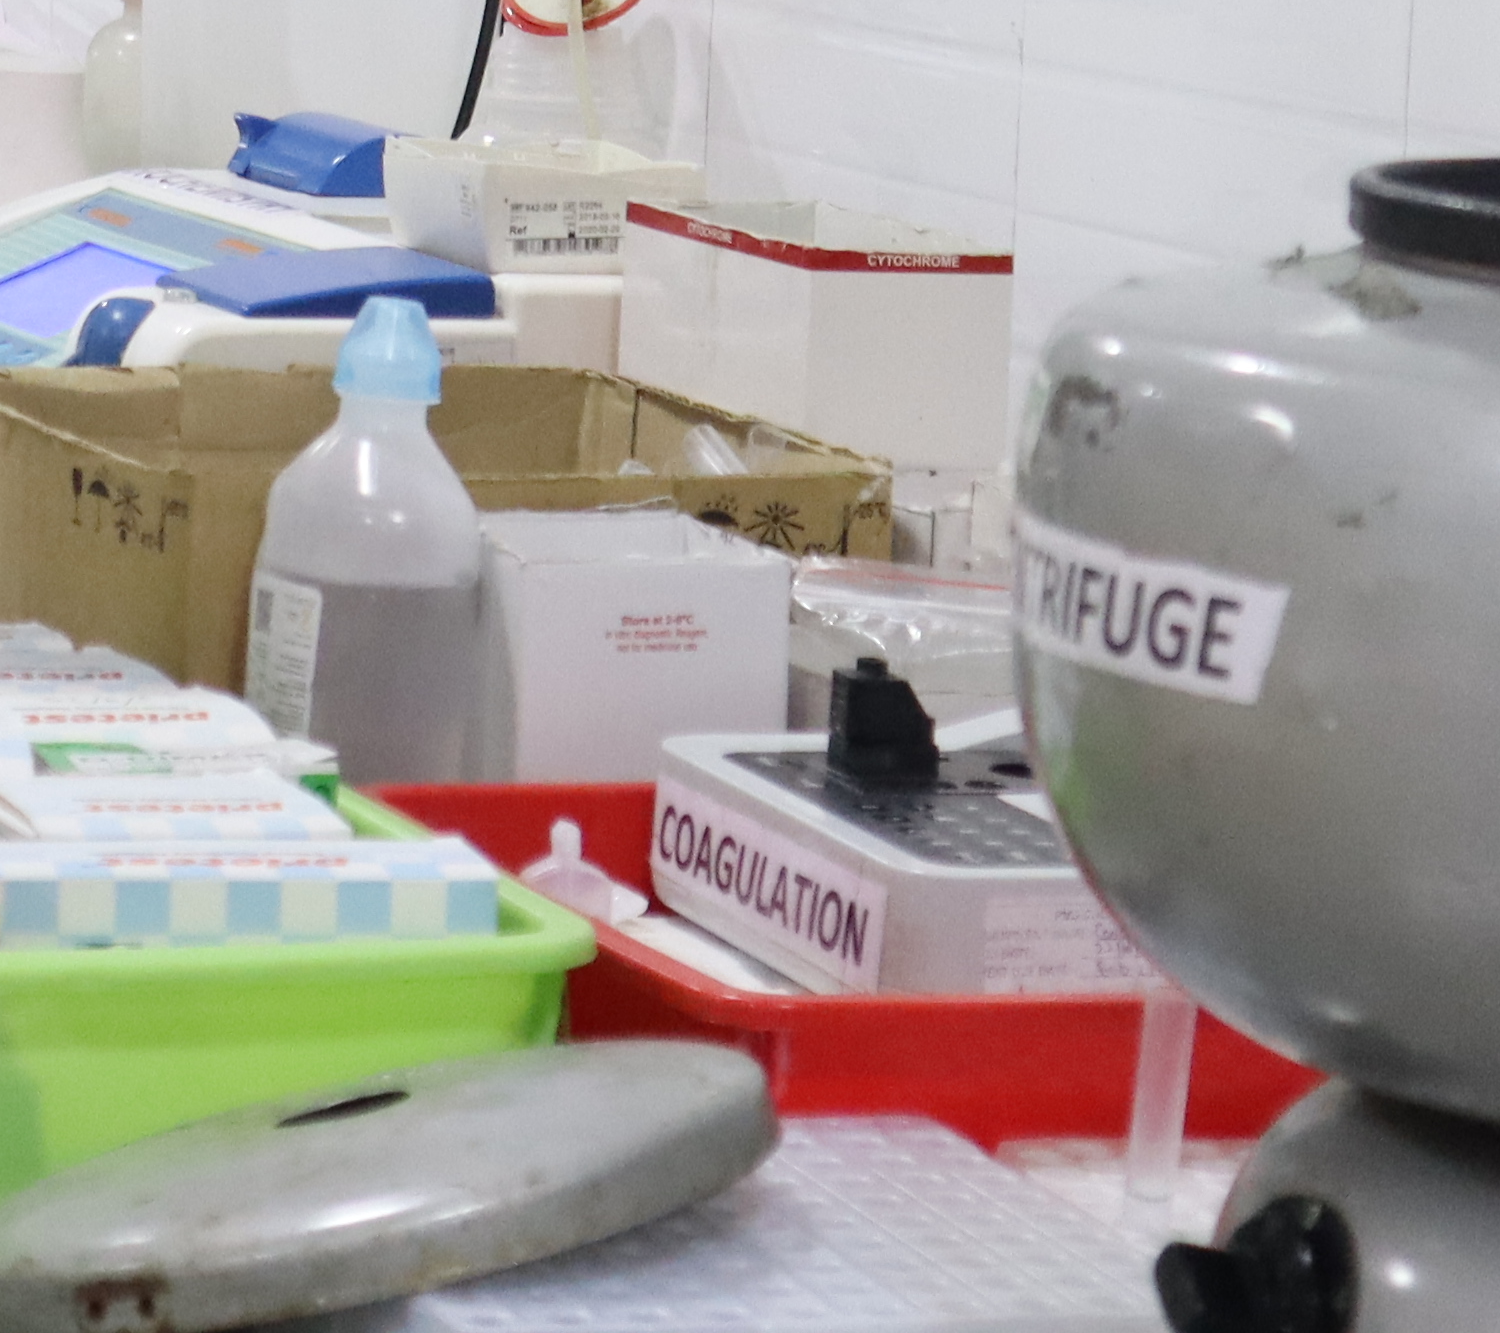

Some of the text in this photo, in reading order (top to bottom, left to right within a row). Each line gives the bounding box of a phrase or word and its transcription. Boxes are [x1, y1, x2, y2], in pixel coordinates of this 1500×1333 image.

[509, 226, 527, 235] Ref
[867, 255, 960, 268] CYTOCHROME
[1019, 543, 1243, 680] TRIFUGE
[621, 616, 649, 626] Store
[653, 617, 662, 625] at
[23, 711, 210, 724] prietest
[84, 802, 284, 813] prietest
[102, 857, 349, 867] prietest
[658, 804, 871, 969] COAGULATION
